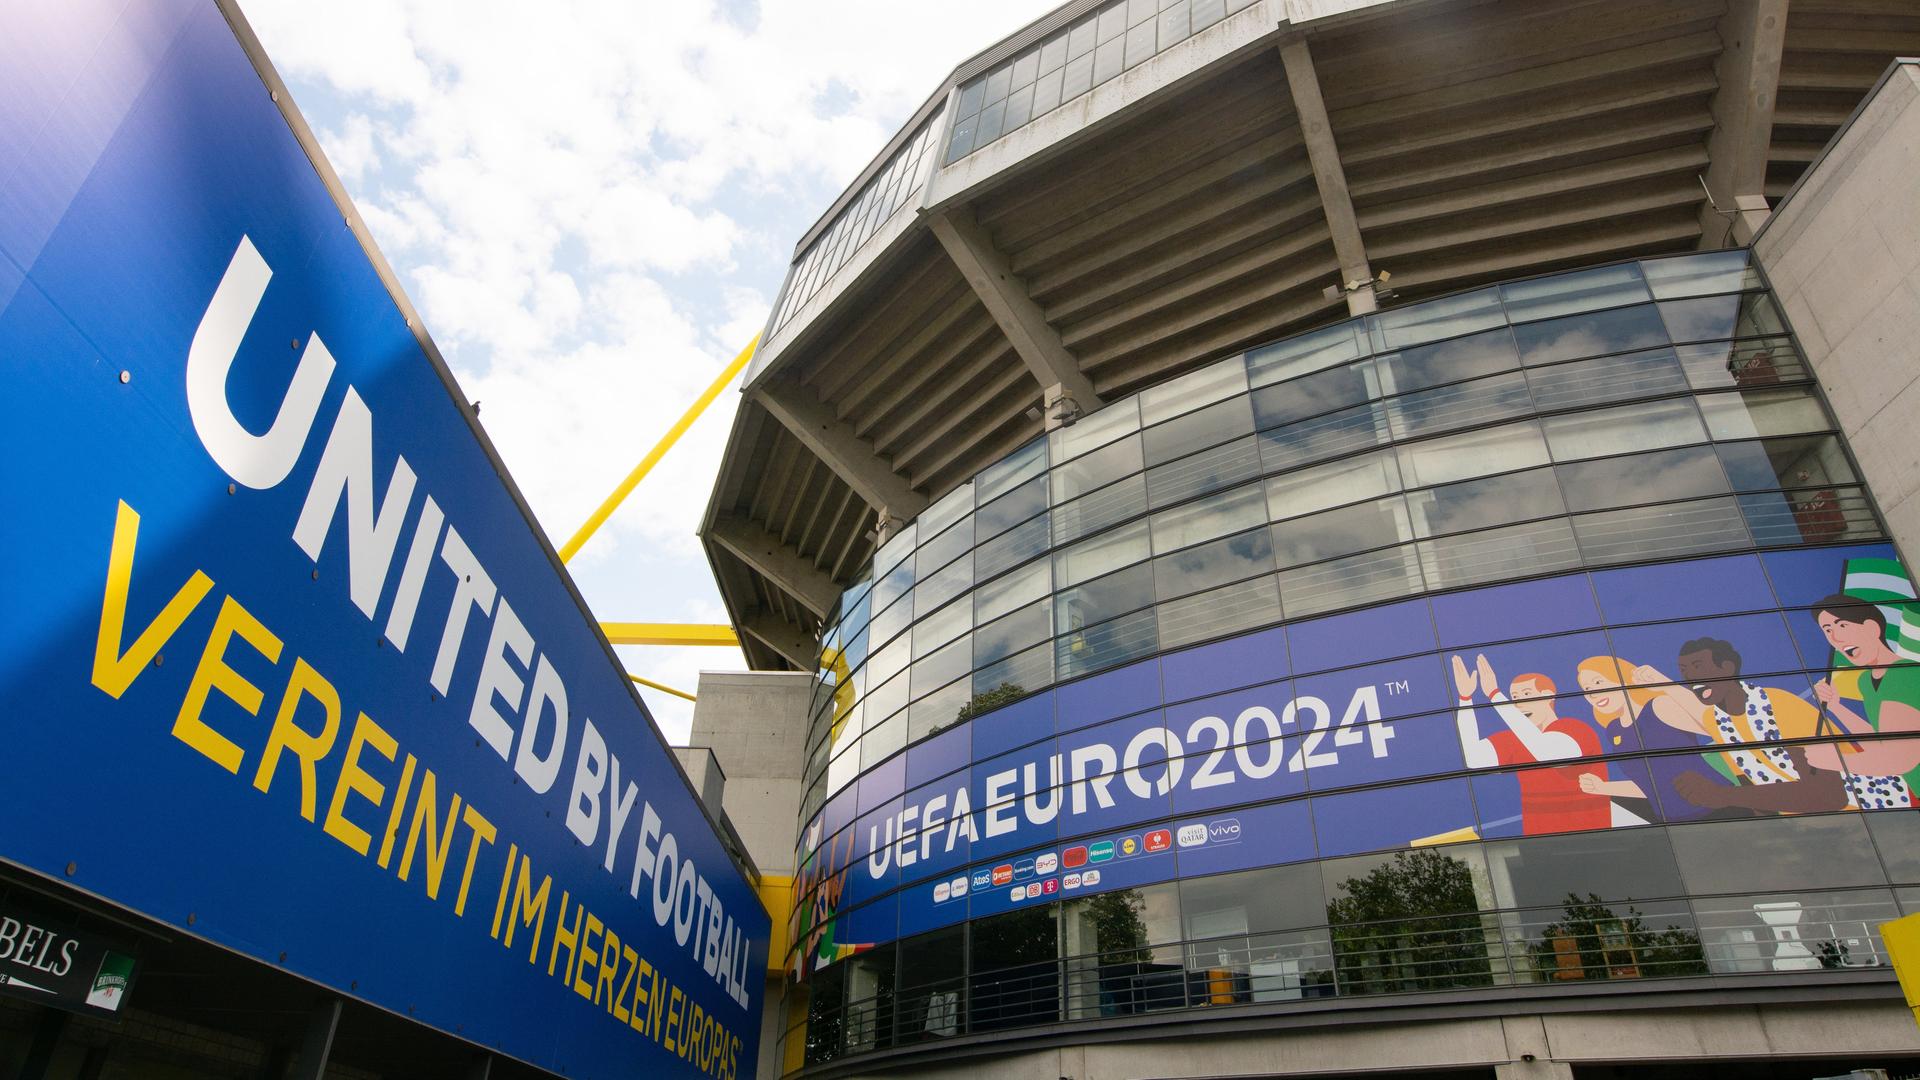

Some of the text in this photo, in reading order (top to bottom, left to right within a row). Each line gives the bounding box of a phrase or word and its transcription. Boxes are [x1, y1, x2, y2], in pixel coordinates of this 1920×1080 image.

[186, 234, 748, 1011] UNITED BY FOOTBALL
[91, 498, 741, 1080] VEREINT IM HERZEN EUROPAS
[868, 787, 979, 880] UEFA
[986, 727, 1185, 837] EURO
[1181, 834, 1204, 843] QATAR
[1209, 825, 1240, 836] vivo
[1064, 878, 1080, 886] ERGO
